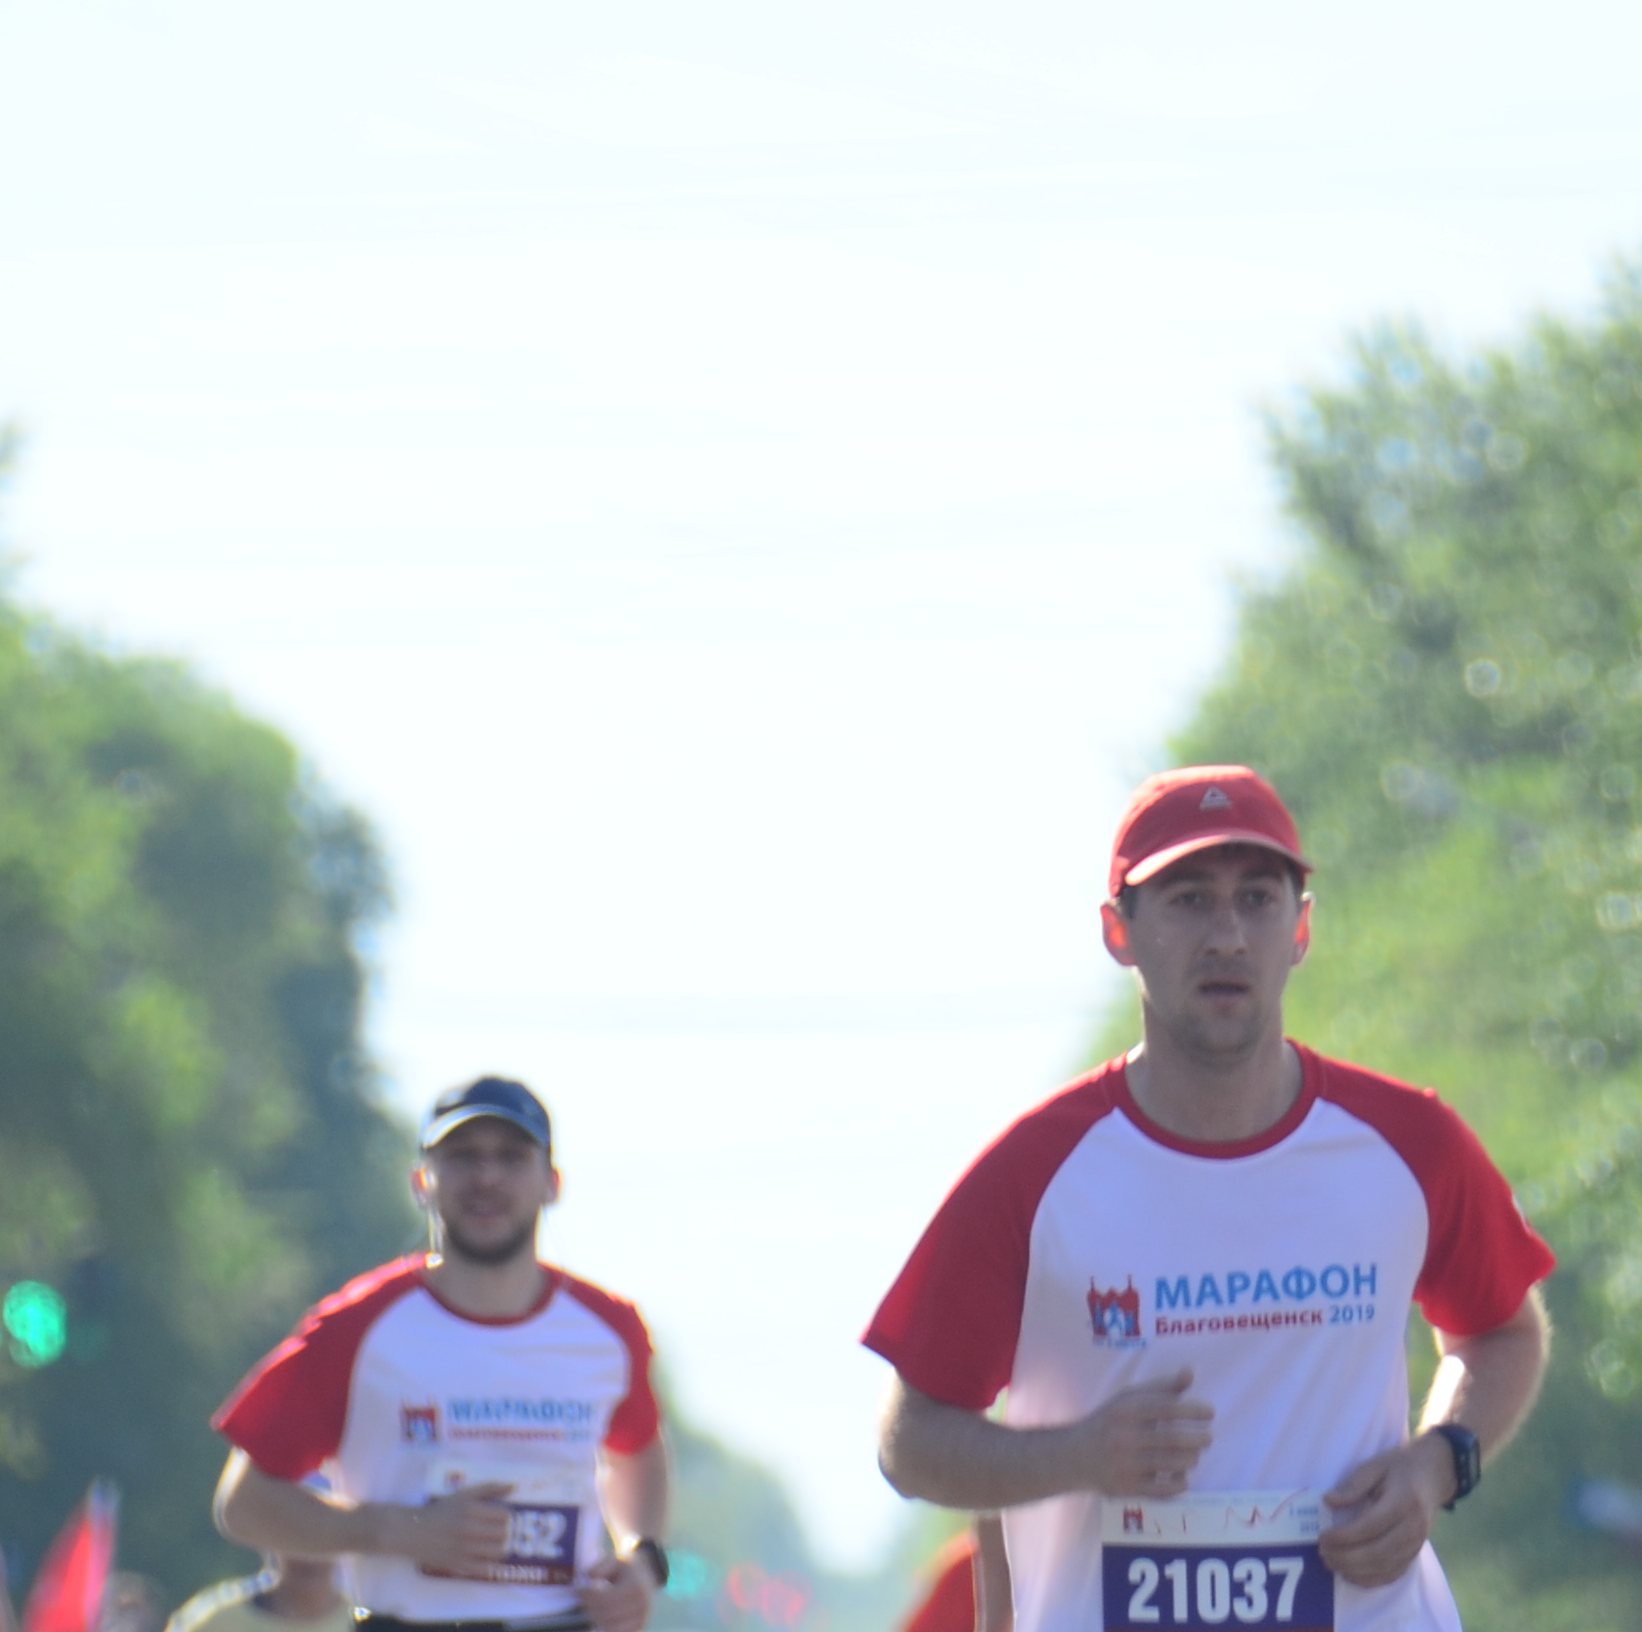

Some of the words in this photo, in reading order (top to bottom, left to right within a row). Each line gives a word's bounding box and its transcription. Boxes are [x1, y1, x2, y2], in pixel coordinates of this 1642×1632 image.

[1155, 1262, 1377, 1309] МАРАФОН
[1155, 1309, 1323, 1337] Благовещенск
[1328, 1304, 1376, 1323] 2019
[1127, 1556, 1304, 1624] 21037
